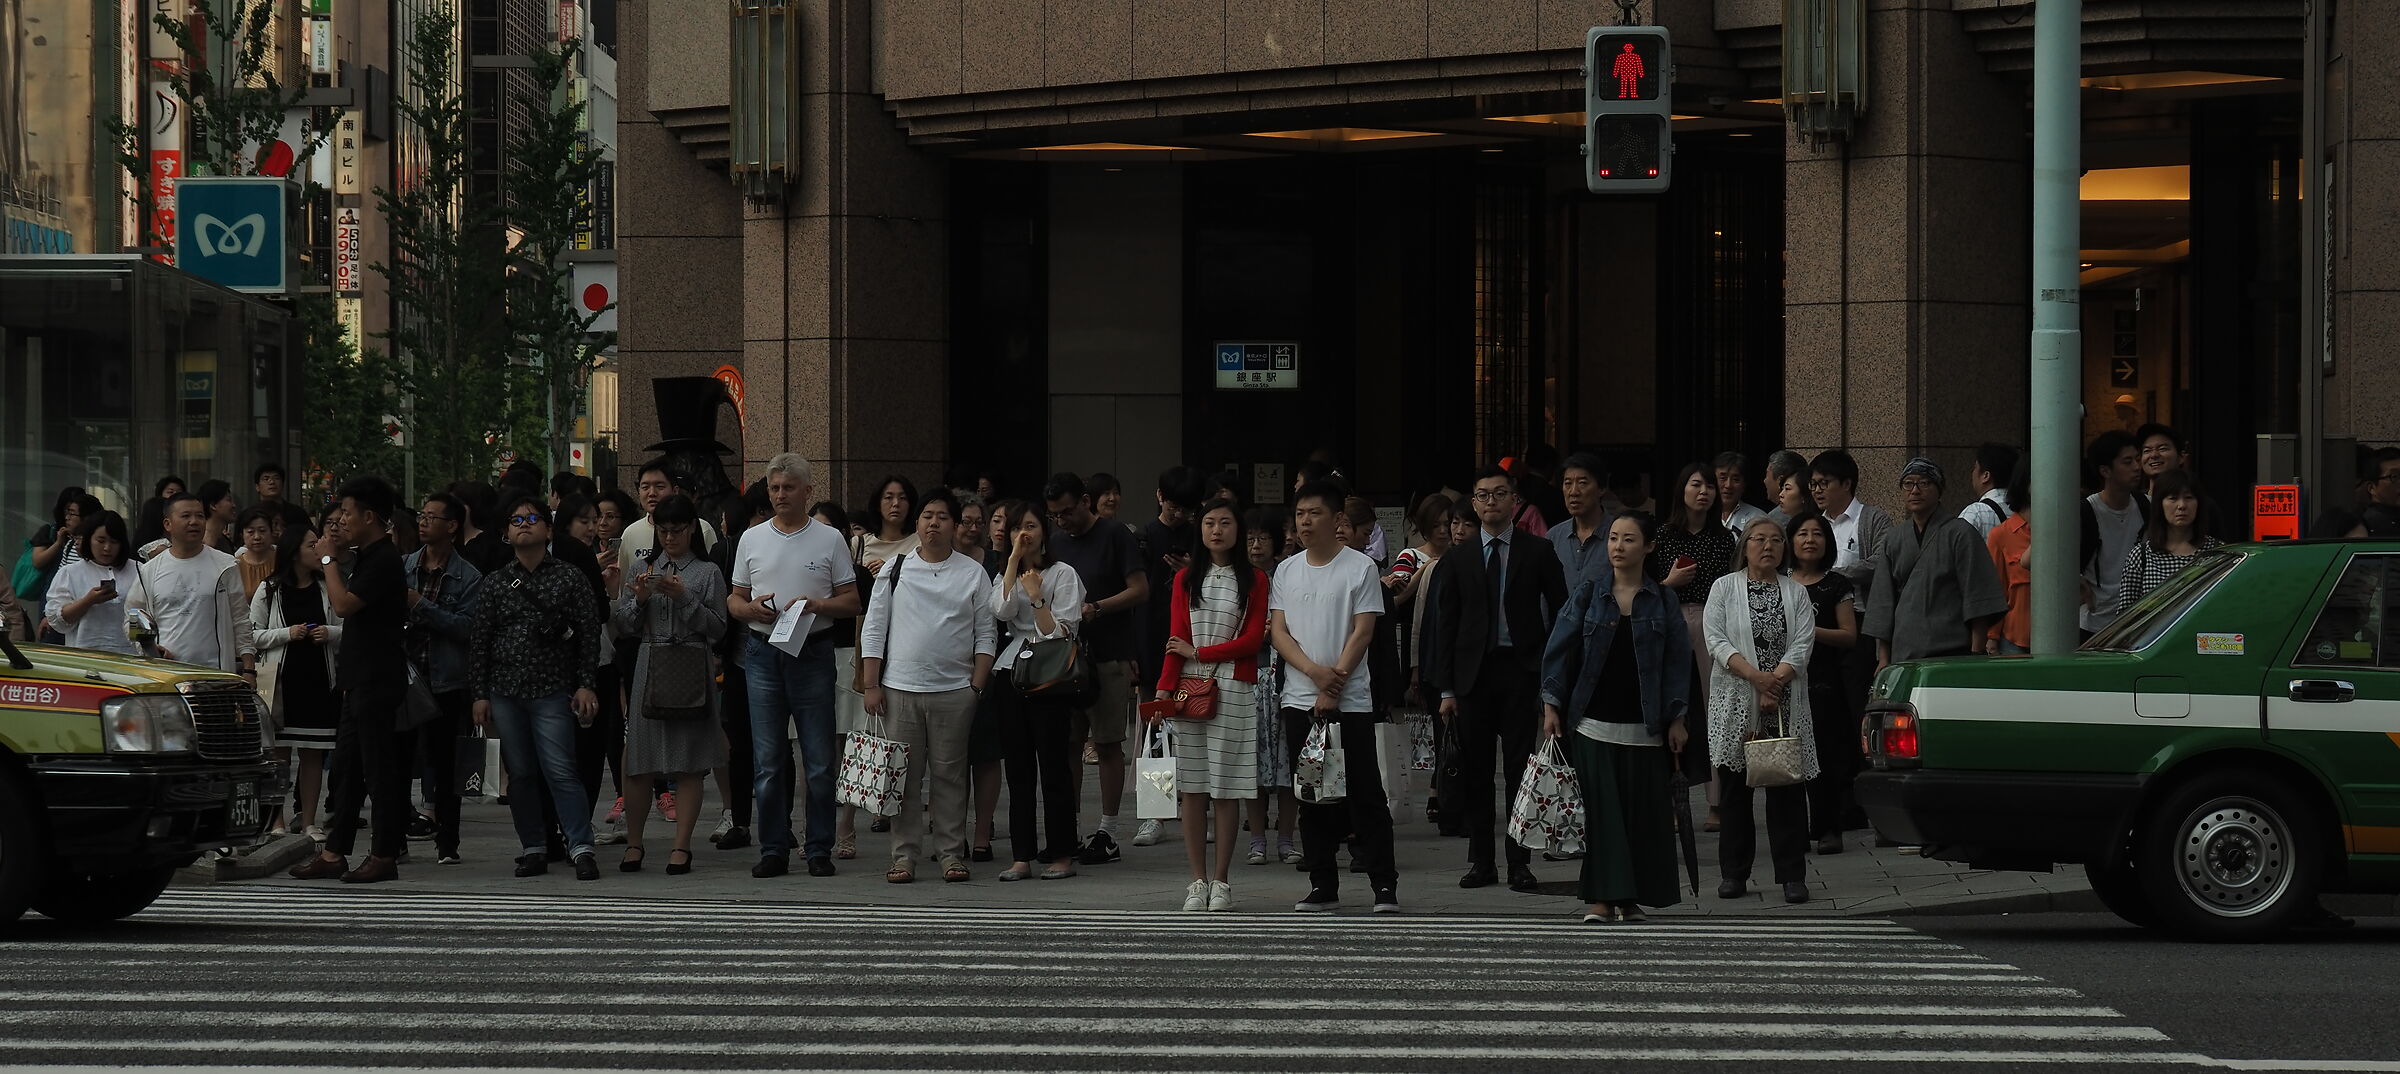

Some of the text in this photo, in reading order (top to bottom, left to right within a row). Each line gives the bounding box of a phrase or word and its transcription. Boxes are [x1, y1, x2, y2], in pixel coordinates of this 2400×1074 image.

[343, 119, 354, 185] 南風ビル
[338, 227, 349, 290] 2990円
[1237, 372, 1277, 382] 銀座駅
[1, 685, 60, 704] (世田谷)
